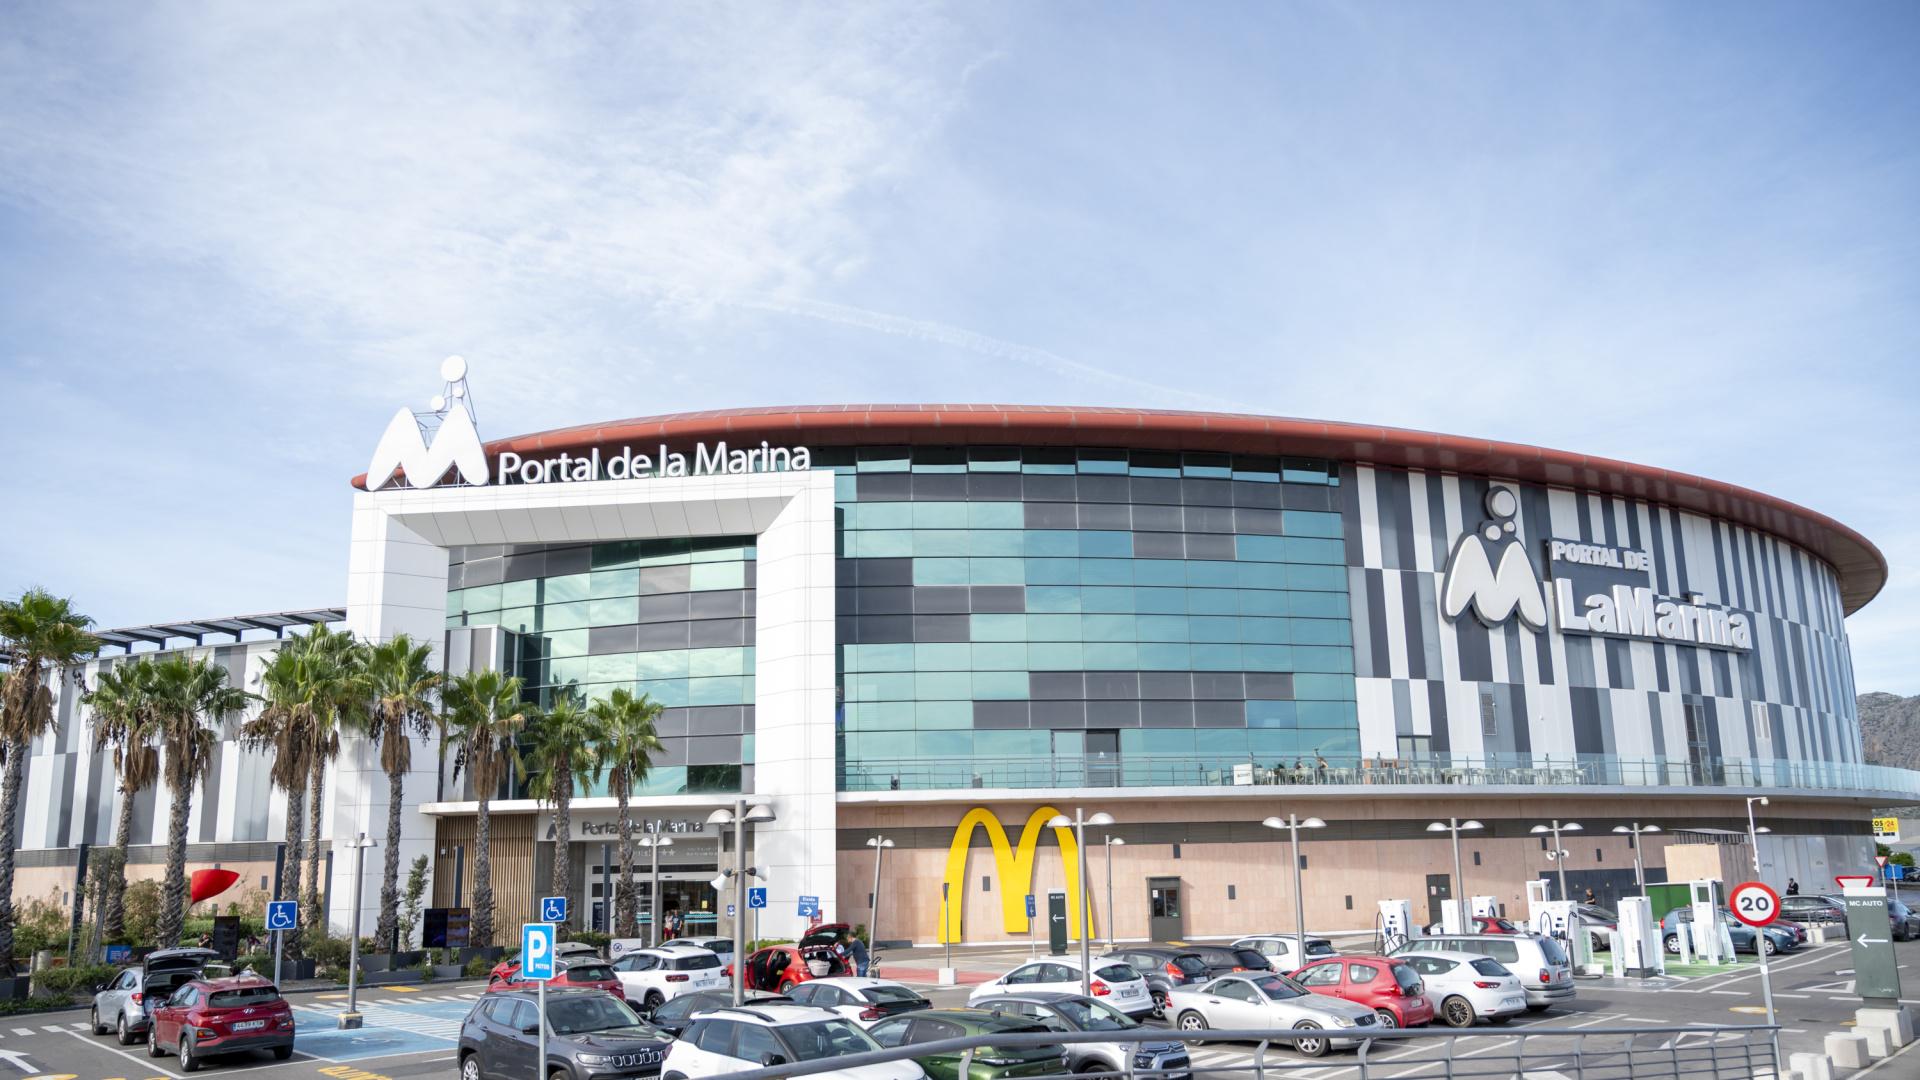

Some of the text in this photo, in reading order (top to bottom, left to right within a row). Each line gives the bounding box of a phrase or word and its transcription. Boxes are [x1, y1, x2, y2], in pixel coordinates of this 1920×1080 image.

[498, 440, 812, 485] Portal de la Marina
[1552, 540, 1650, 572] PORTAL DE
[1555, 577, 1754, 650] LaMarina
[581, 820, 620, 835] Porta
[657, 819, 704, 833] Marina
[1740, 896, 1769, 911] 20
[527, 930, 547, 973] P
